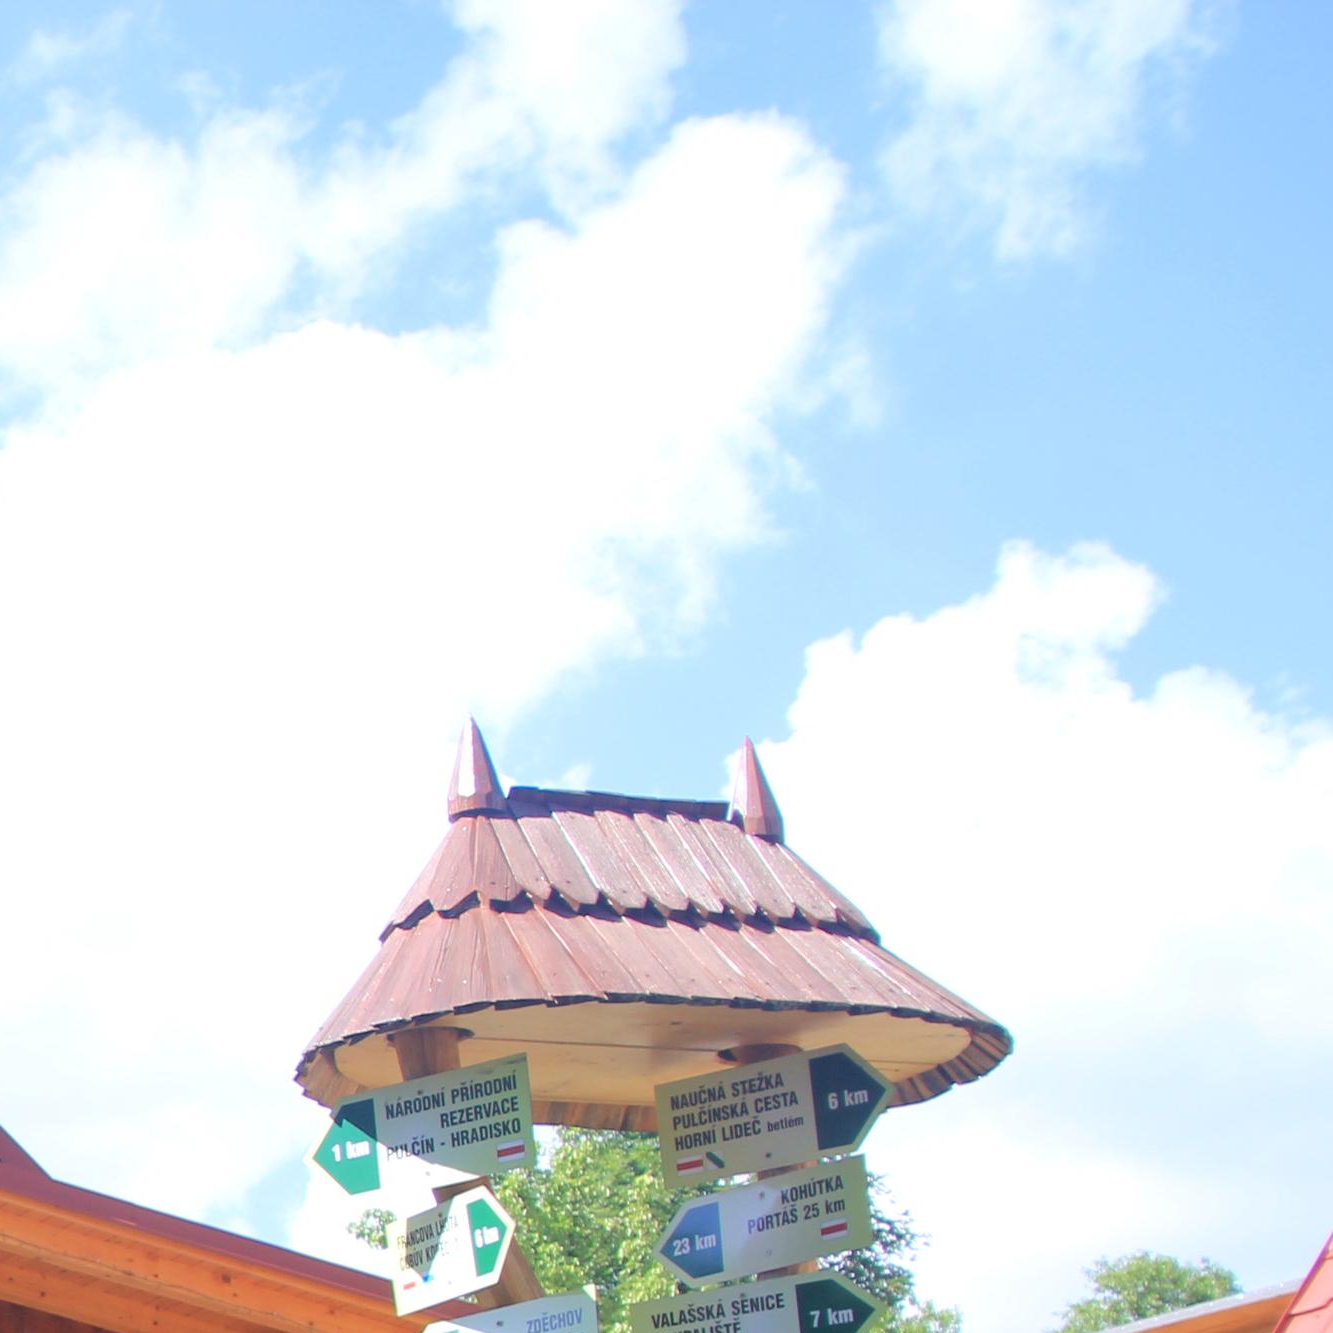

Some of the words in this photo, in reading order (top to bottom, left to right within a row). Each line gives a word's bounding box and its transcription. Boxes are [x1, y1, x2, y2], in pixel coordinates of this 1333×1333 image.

[385, 1087, 446, 1120] NÁRODNÍ
[451, 1072, 518, 1104] PŘÍRODNÍ
[670, 1081, 726, 1111] NAUČNÁ
[731, 1071, 784, 1098] STEŽKA
[828, 1093, 839, 1109] 6
[843, 1089, 869, 1106] km
[440, 1096, 520, 1129] REZERVACE
[673, 1098, 750, 1131] PULČÍNSKÁ
[754, 1091, 799, 1114] CESTA
[386, 1135, 435, 1161] PULČÍN
[451, 1118, 522, 1147] HRADISKO
[675, 1127, 717, 1151] HORNÍ
[721, 1116, 762, 1142] LIDEČ
[331, 1144, 342, 1162] 1
[780, 1175, 845, 1205] KOHÚTKA
[747, 1206, 798, 1234] PORTÁŠ
[804, 1203, 820, 1221] 25
[824, 1199, 846, 1215] km
[672, 1237, 691, 1257] 23
[695, 1233, 717, 1250] km
[651, 1299, 726, 1329] VALAŠSKÁ
[731, 1293, 786, 1317] SENICE
[809, 1311, 821, 1328] 7
[827, 1307, 854, 1325] km
